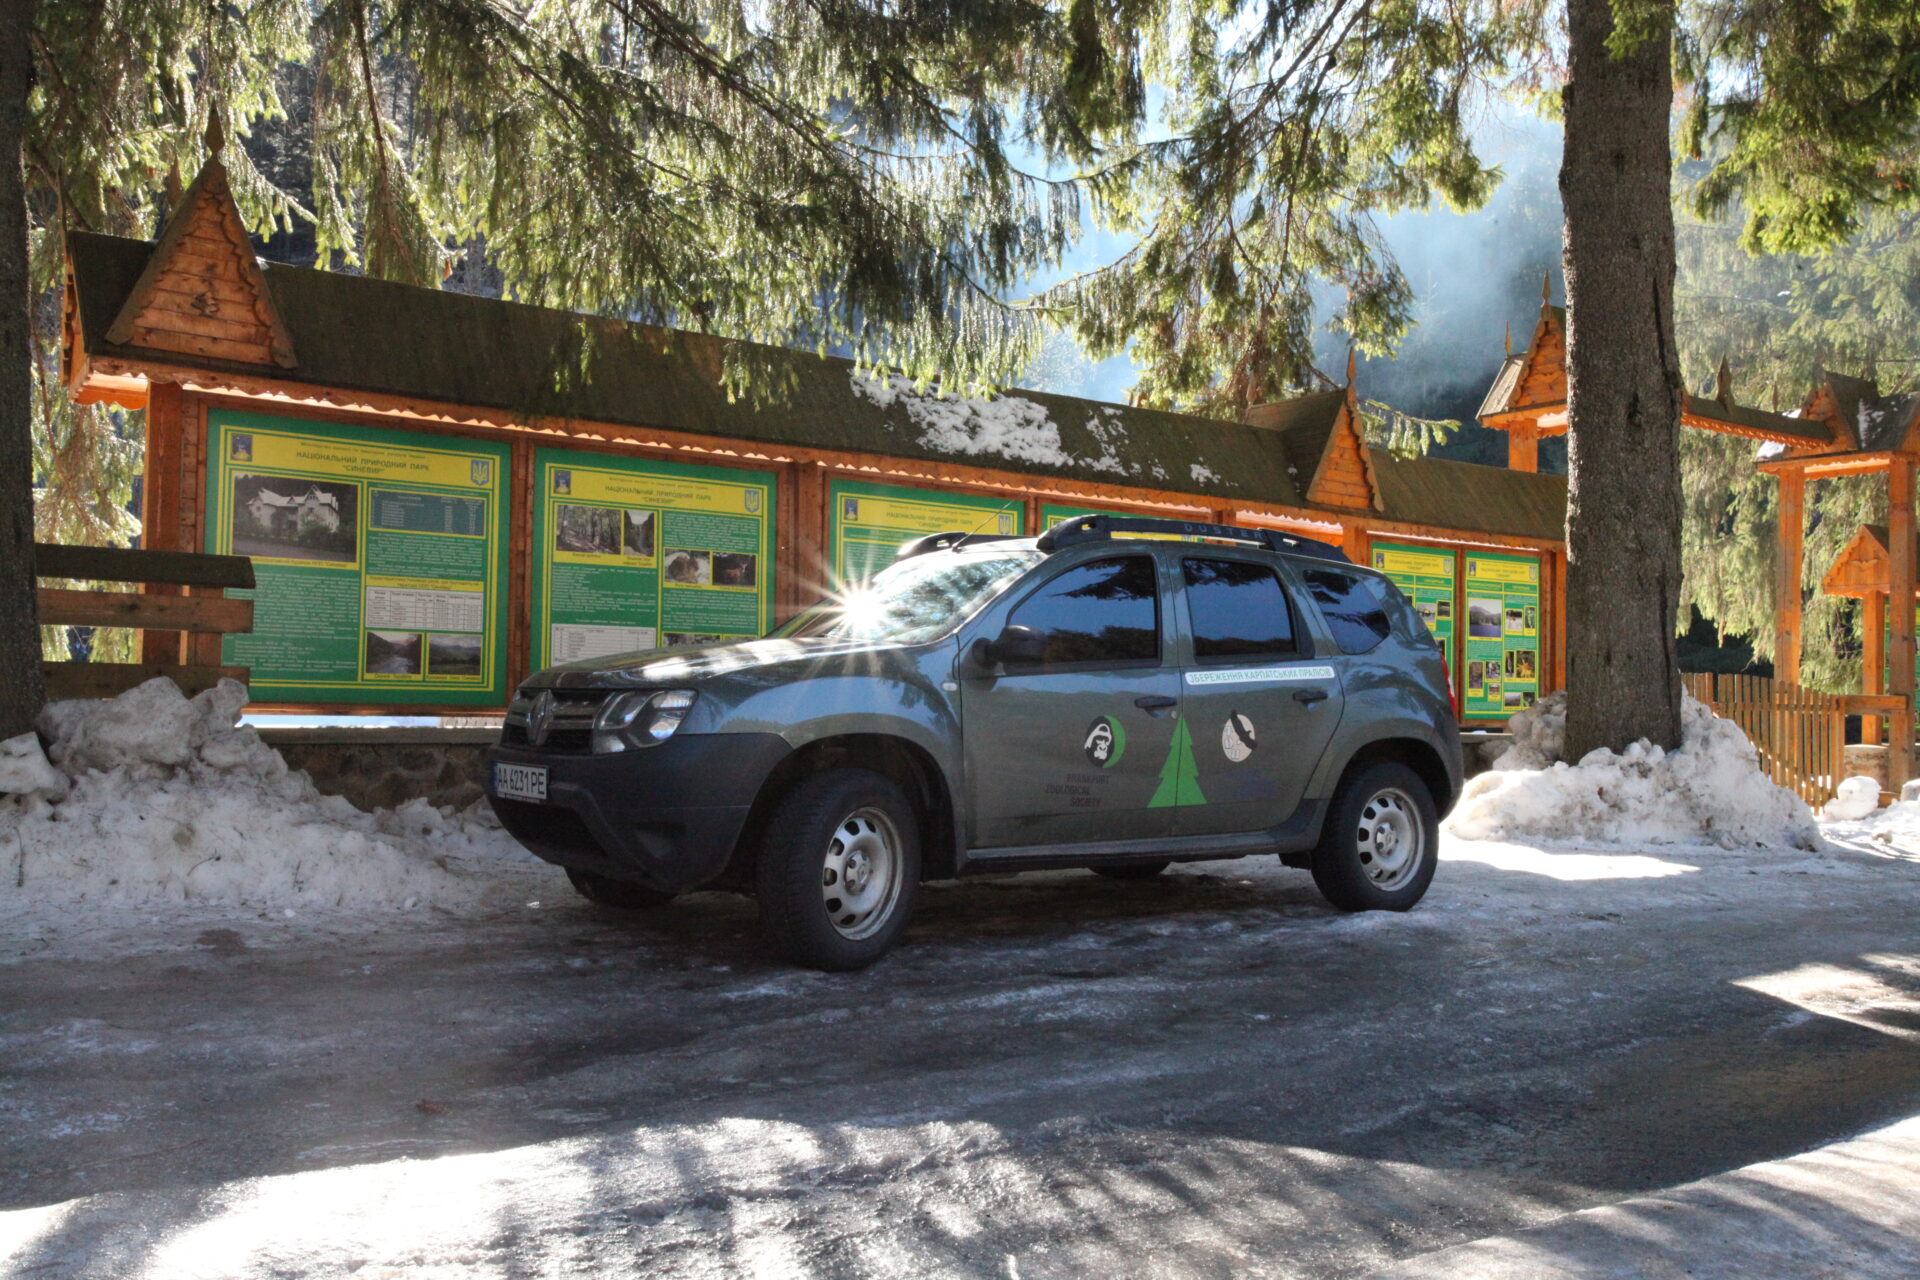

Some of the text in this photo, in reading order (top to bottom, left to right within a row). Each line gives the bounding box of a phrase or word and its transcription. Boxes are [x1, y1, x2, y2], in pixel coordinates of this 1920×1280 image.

[1184, 523, 1263, 540] DUSTER
[1189, 668, 1331, 683] ЗБЕРЕЖЕННЯ КАРПАТСЬКИХ ПРАЛІСІВ
